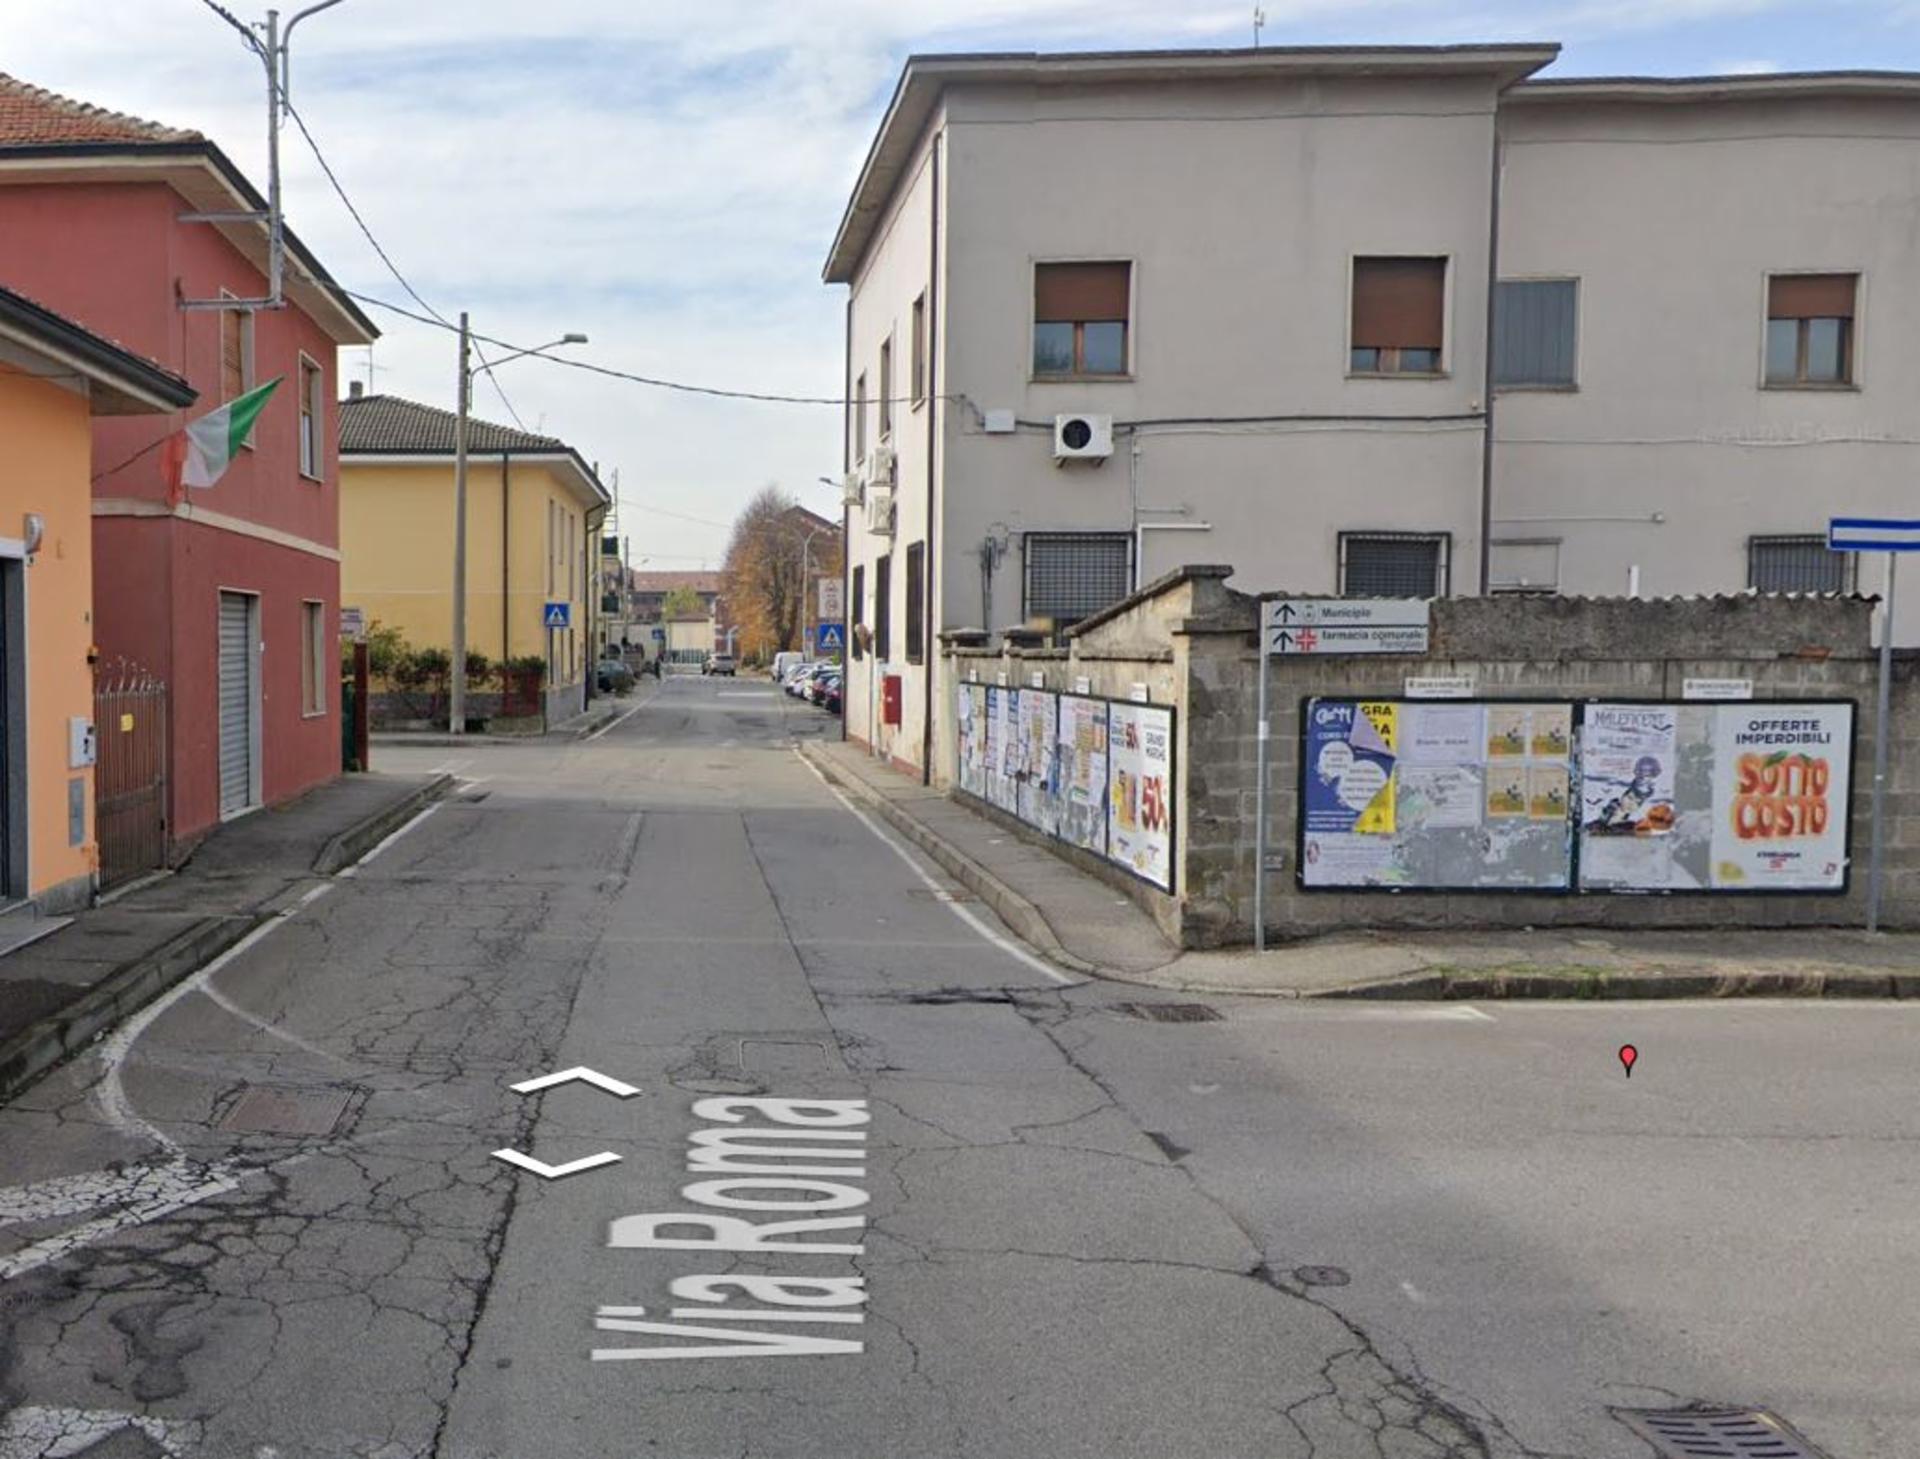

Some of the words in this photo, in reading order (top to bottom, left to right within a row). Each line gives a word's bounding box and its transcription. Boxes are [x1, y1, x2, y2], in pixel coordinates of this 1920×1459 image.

[1322, 607, 1371, 619] Municipio
[1322, 630, 1369, 640] farmacia
[1372, 630, 1423, 640] comunale
[1748, 720, 1821, 732] OFFERTE
[1735, 732, 1831, 744] IMPERDIBILI
[1736, 752, 1829, 797] SOTTO
[1734, 797, 1829, 840] COSTO
